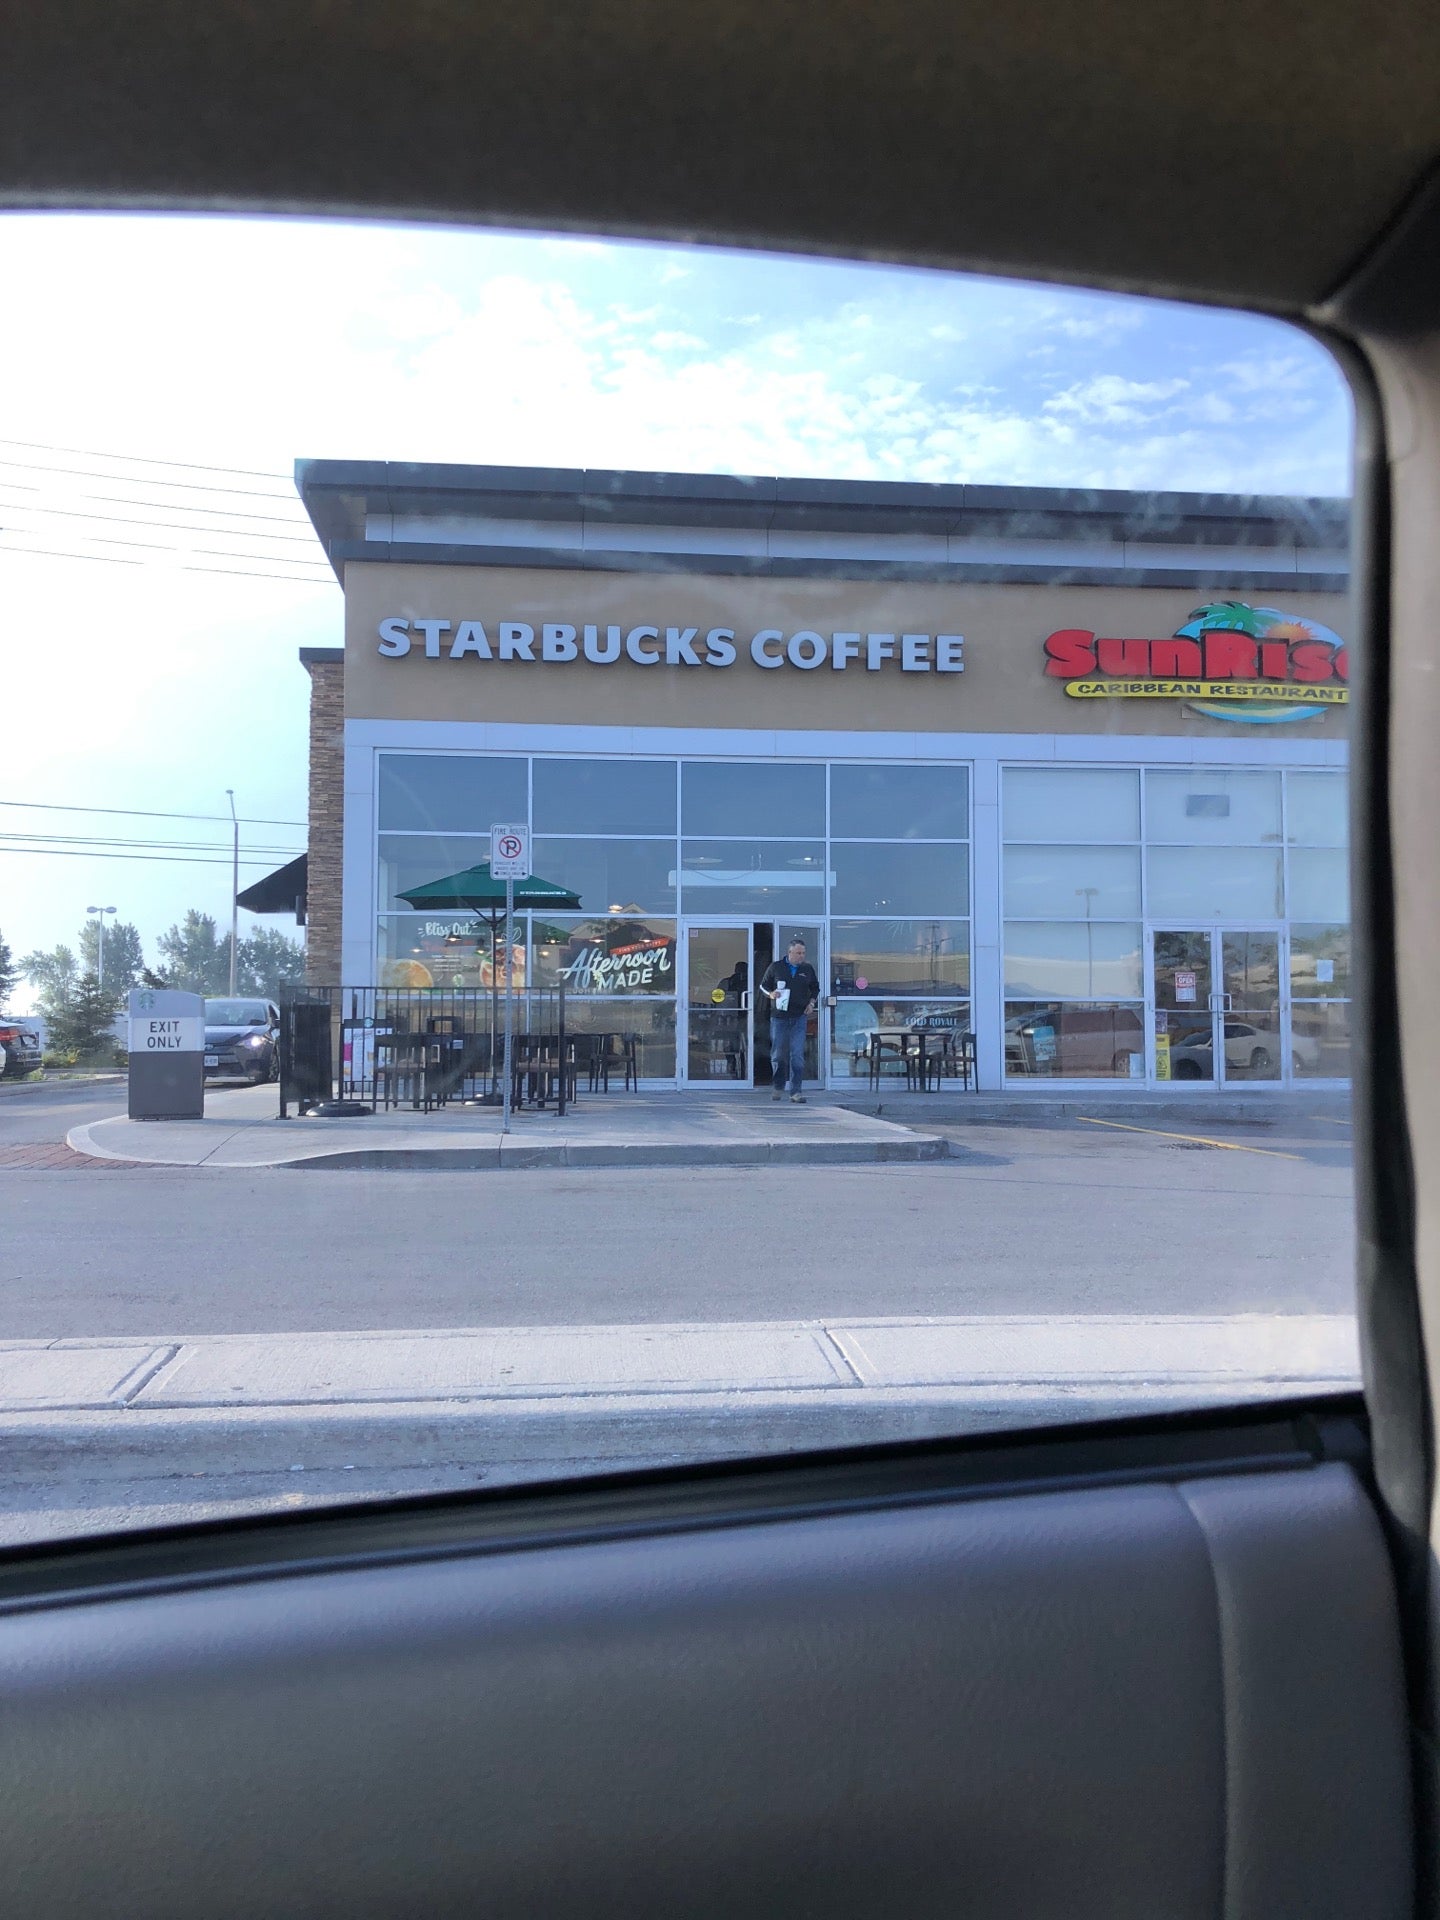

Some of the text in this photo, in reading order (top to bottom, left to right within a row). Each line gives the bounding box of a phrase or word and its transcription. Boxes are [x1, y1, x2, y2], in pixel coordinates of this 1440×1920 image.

[377, 617, 965, 672] STARBUCKS COFFEE
[1077, 683, 1348, 700] CARIBBEAN RESTAURANT
[425, 922, 472, 936] Bliss Out
[556, 947, 671, 989] Afternoon
[598, 968, 654, 991] MADE
[150, 1021, 180, 1033] EXIT
[147, 1036, 182, 1048] ONLY
